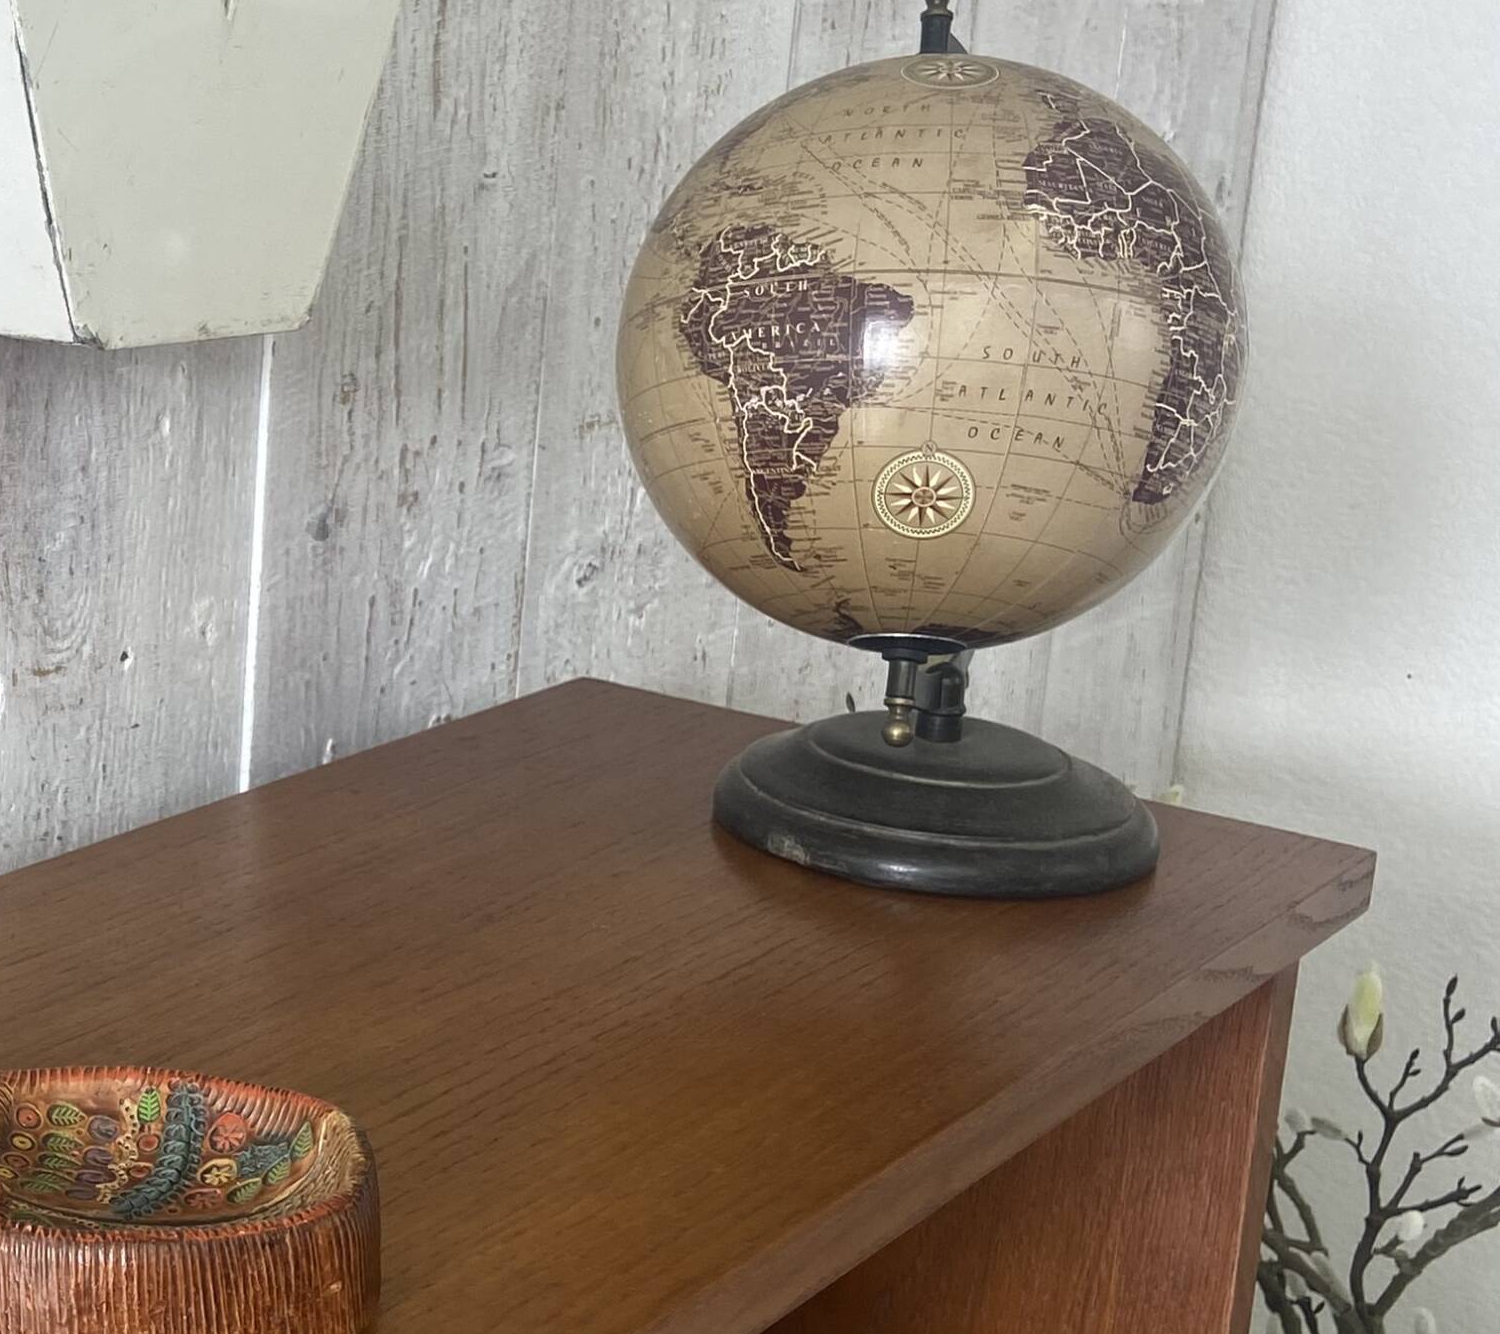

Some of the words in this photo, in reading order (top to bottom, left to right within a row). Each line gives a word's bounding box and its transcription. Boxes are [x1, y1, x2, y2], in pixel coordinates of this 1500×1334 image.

[842, 102, 932, 118] NORTH
[817, 127, 965, 145] ATLANTIC
[831, 156, 924, 173] OCEAN
[743, 279, 809, 298] SOUTH
[729, 322, 822, 341] AMERICA
[981, 345, 1081, 368] SOUTH
[957, 384, 1108, 416] ATLANTIC
[966, 425, 1065, 450] OCEAN
